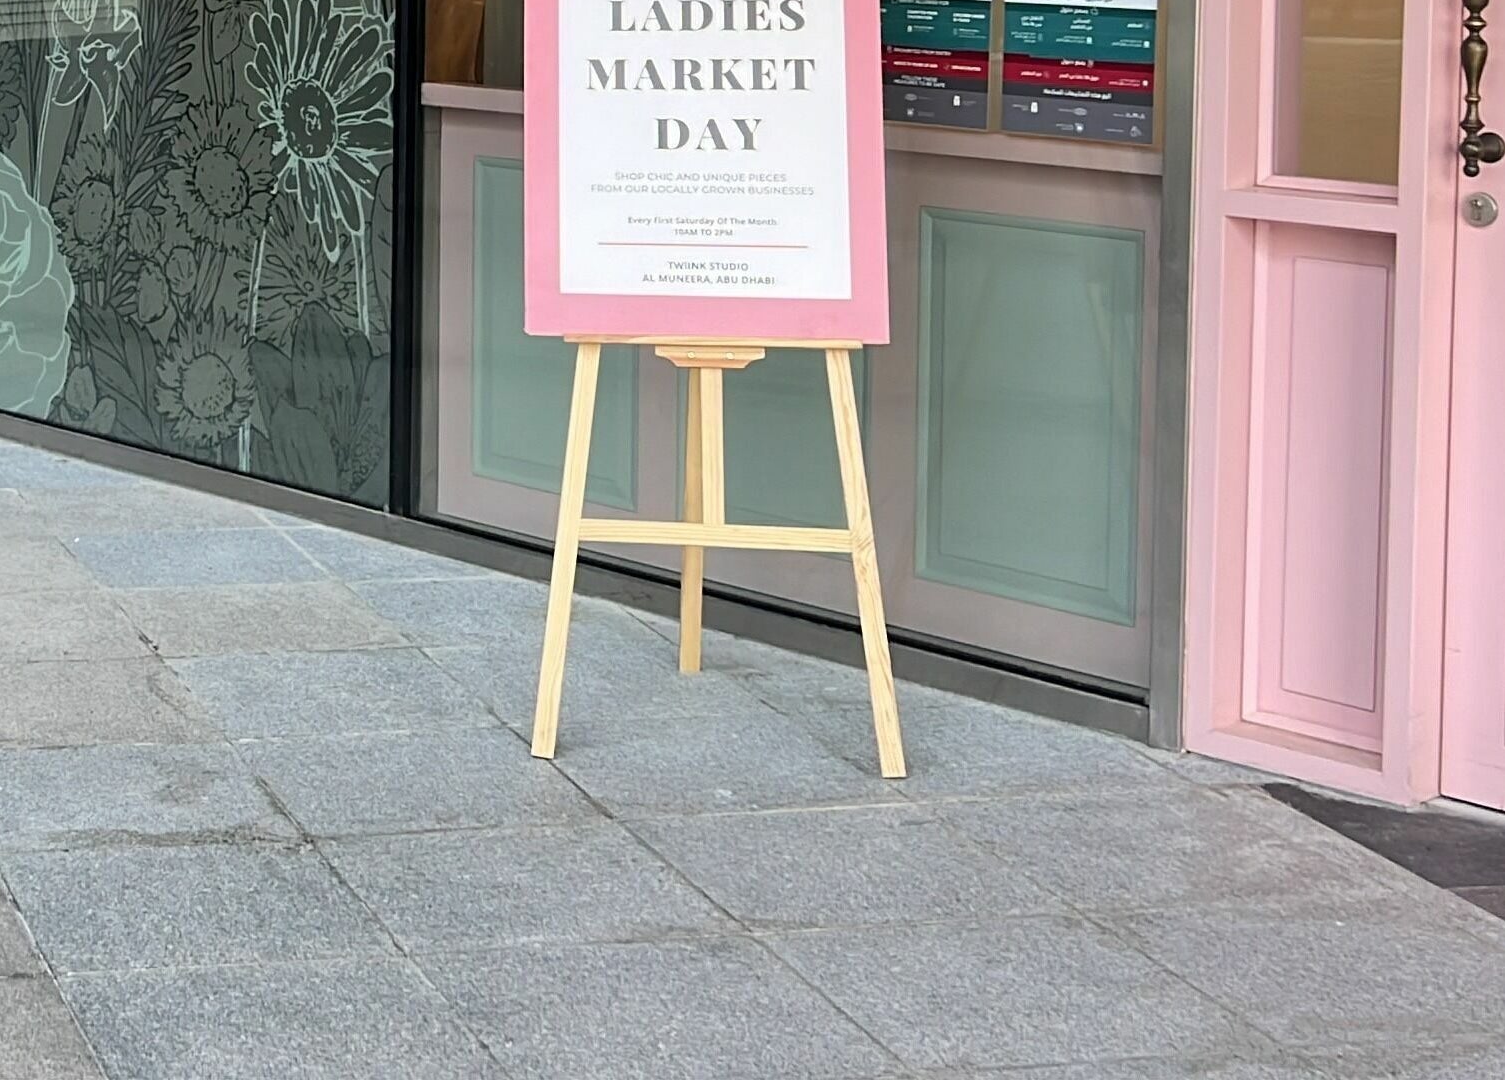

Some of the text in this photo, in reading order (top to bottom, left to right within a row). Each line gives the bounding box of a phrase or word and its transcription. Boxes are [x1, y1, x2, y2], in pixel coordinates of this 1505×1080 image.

[609, 0, 806, 32] LADIES
[586, 58, 816, 91] MARKET
[655, 118, 762, 151] DAY
[614, 171, 788, 183] SHOP CHIC AND UNIQUE PIECES
[590, 183, 815, 196] FROM OUR LOCALLY GROWN BUSINESSES
[627, 216, 651, 226] Every
[675, 216, 715, 227] Saturday
[729, 217, 746, 226] The
[700, 229, 712, 237] TO
[714, 229, 734, 238] 2PM
[709, 262, 749, 272] STUDIO
[642, 273, 776, 286] AL MUNEERA, ABU DHABI
